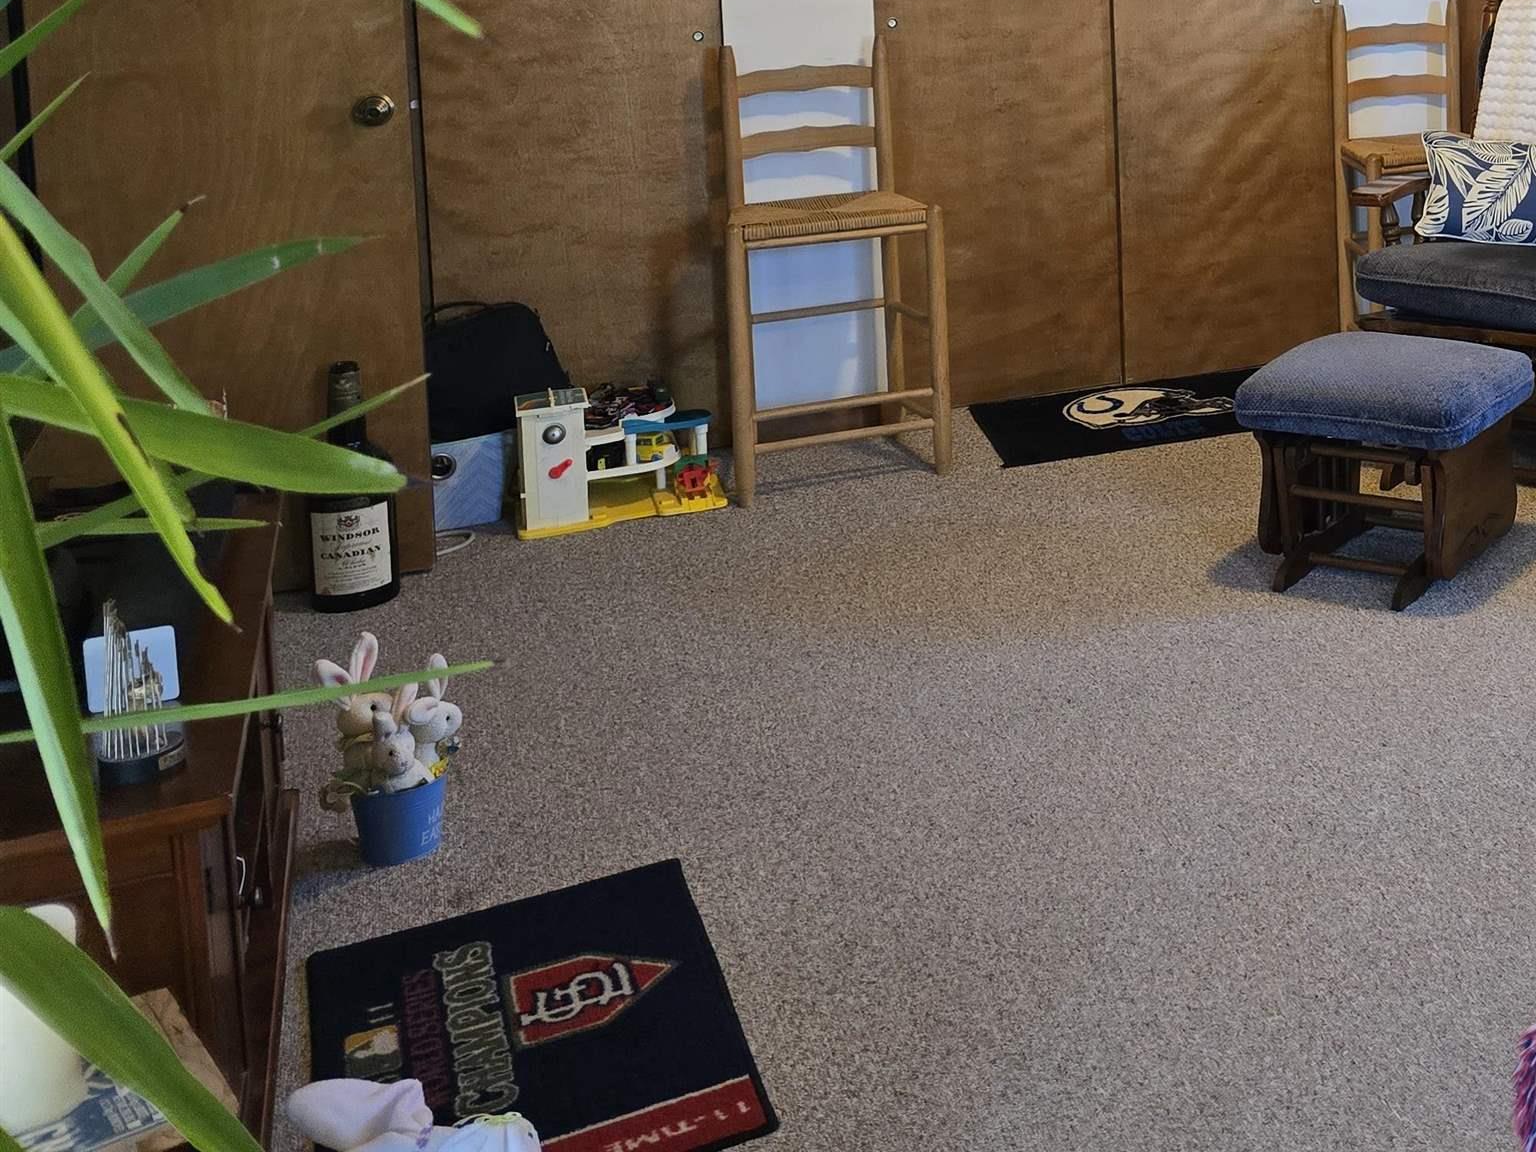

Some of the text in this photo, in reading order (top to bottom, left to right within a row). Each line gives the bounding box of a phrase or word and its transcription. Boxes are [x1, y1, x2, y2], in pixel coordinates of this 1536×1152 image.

[320, 527, 380, 542] WINDSOR
[320, 545, 381, 561] CANADIAN
[432, 941, 520, 1118] CHAMPIONS
